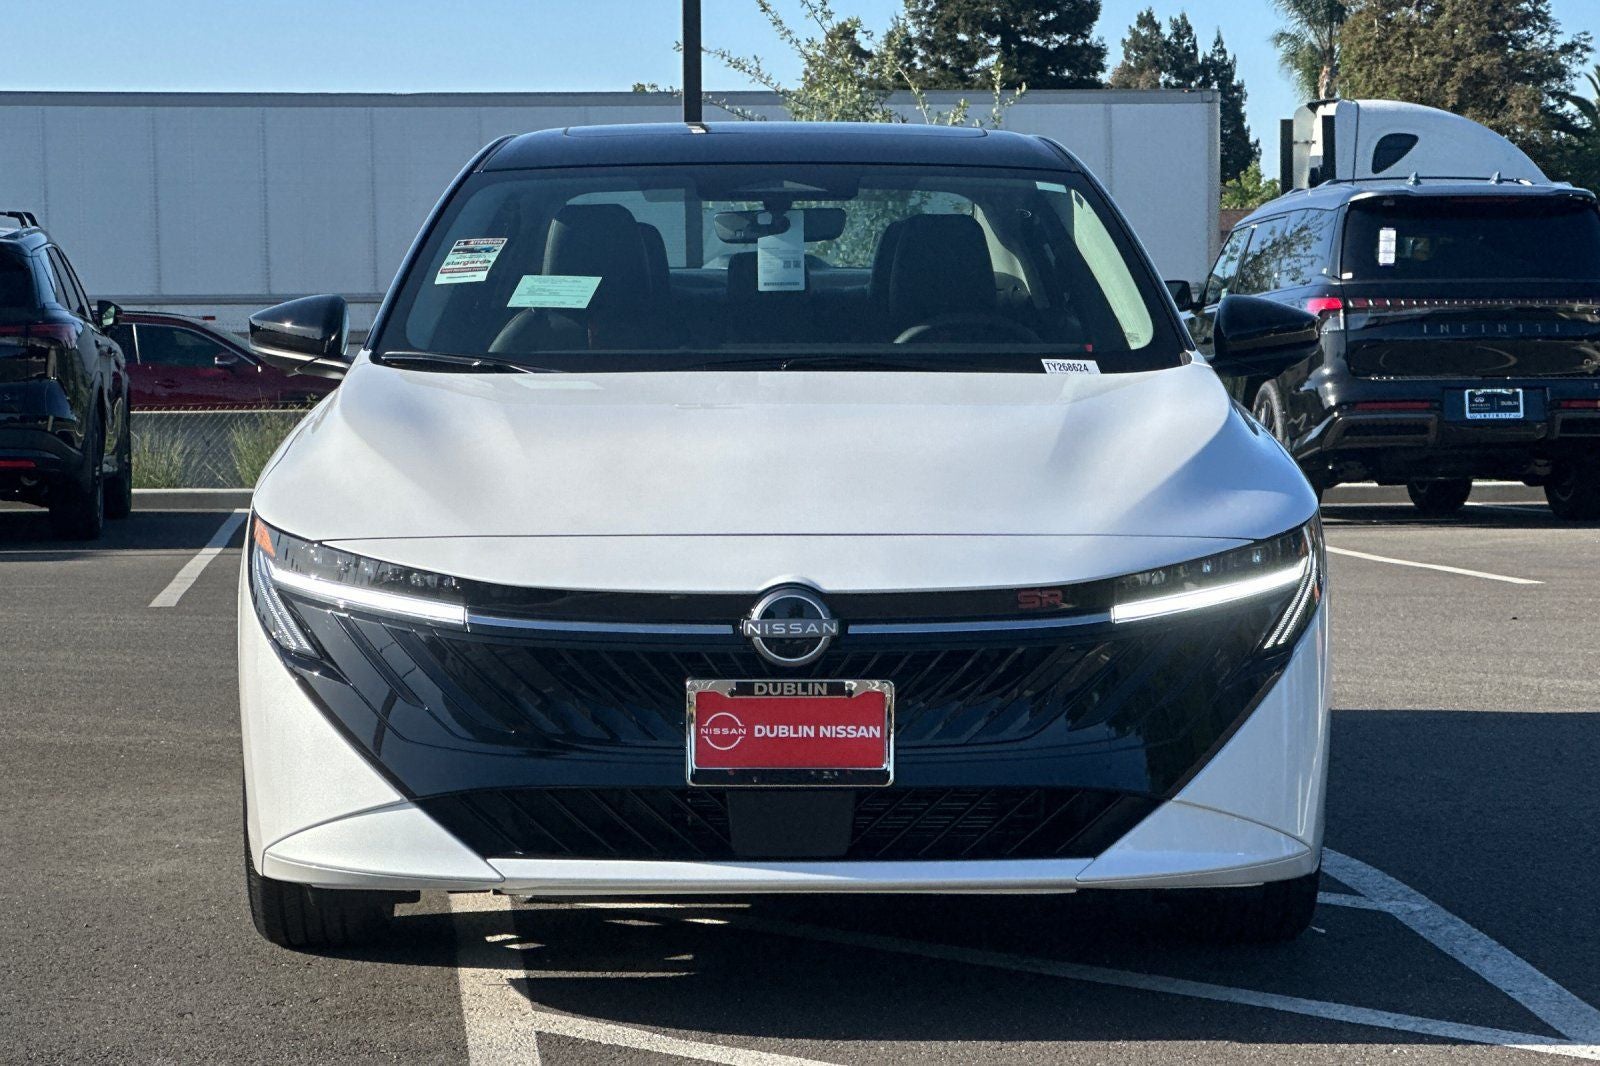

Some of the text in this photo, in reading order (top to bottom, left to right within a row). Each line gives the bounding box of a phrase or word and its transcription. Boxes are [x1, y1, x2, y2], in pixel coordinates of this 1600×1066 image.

[1017, 590, 1066, 610] SR
[747, 622, 837, 635] NISSAN
[753, 682, 828, 696] DUBLIN
[700, 727, 747, 736] NISSAN
[753, 725, 881, 739] DUBLIN NISSAN
